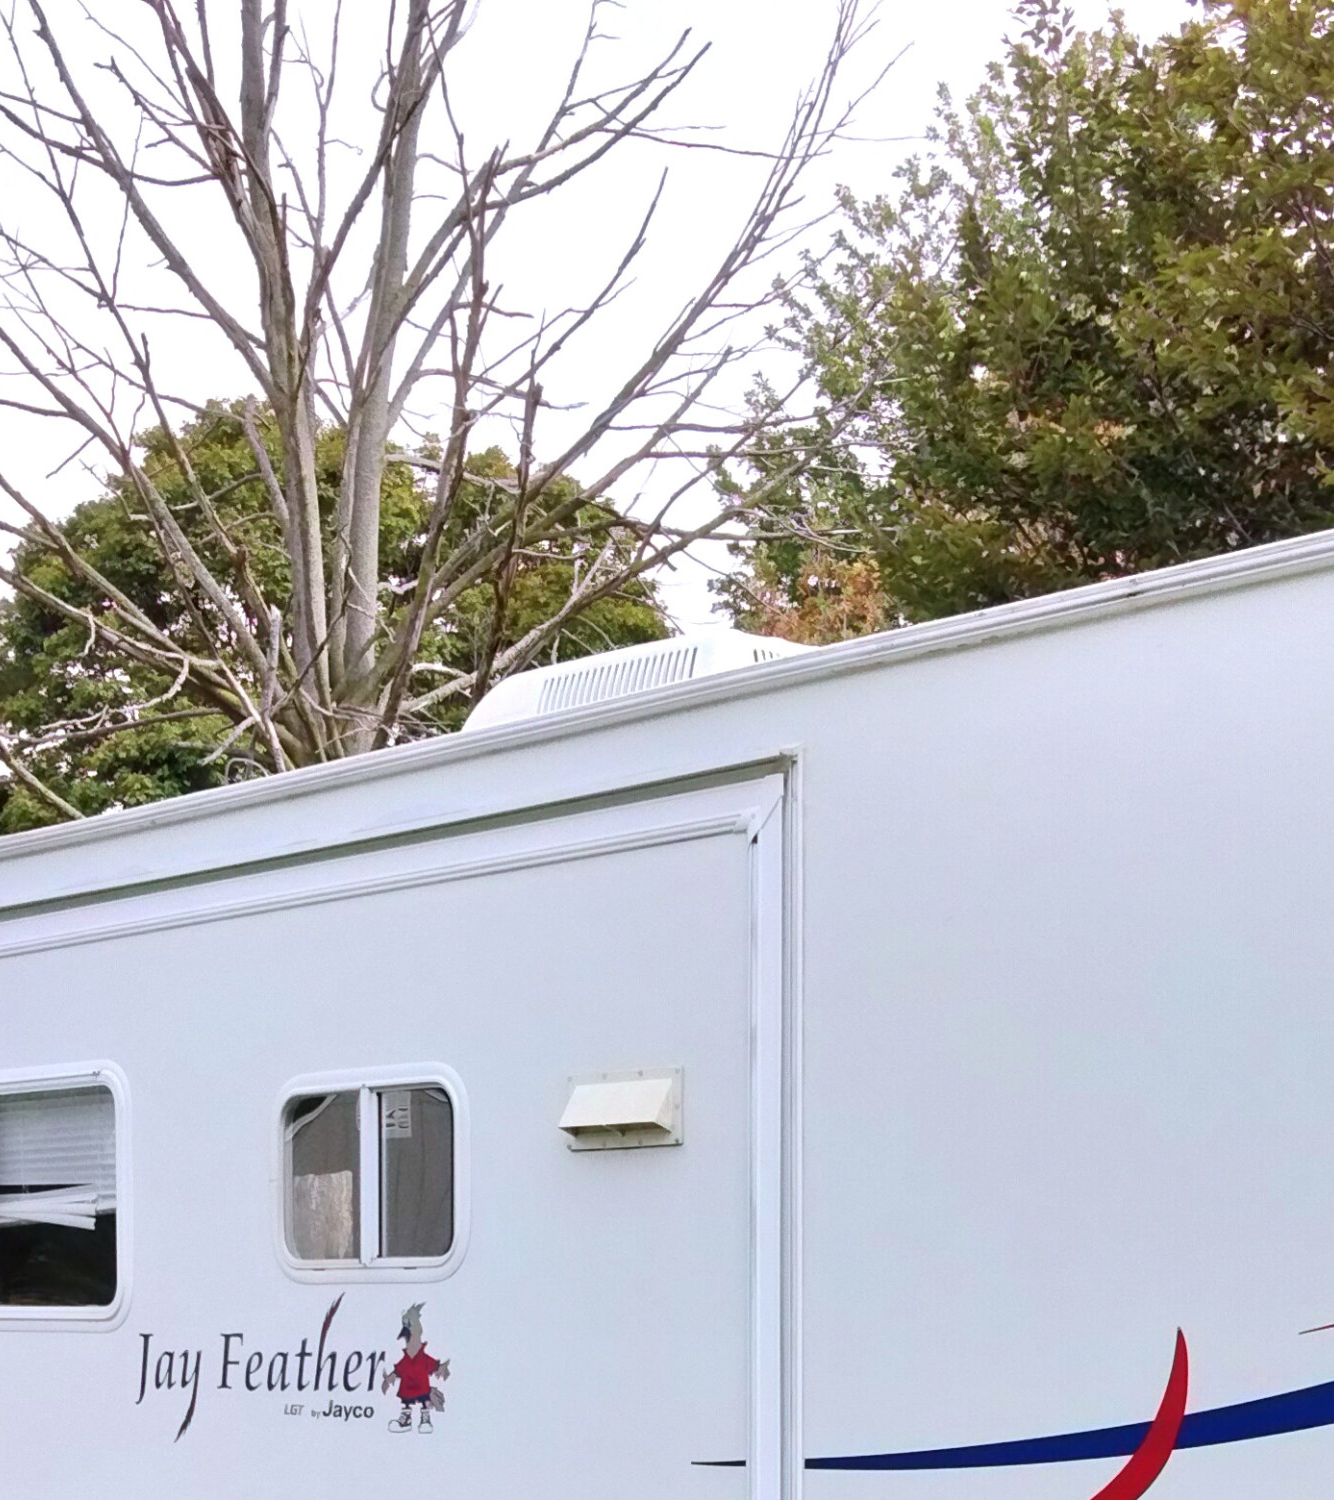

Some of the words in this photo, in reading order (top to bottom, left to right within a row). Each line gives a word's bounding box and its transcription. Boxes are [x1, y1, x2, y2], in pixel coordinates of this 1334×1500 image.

[135, 1333, 202, 1443] Jay
[217, 1292, 386, 1392] Feather
[311, 1409, 322, 1419] by
[322, 1399, 375, 1421] Jayco
